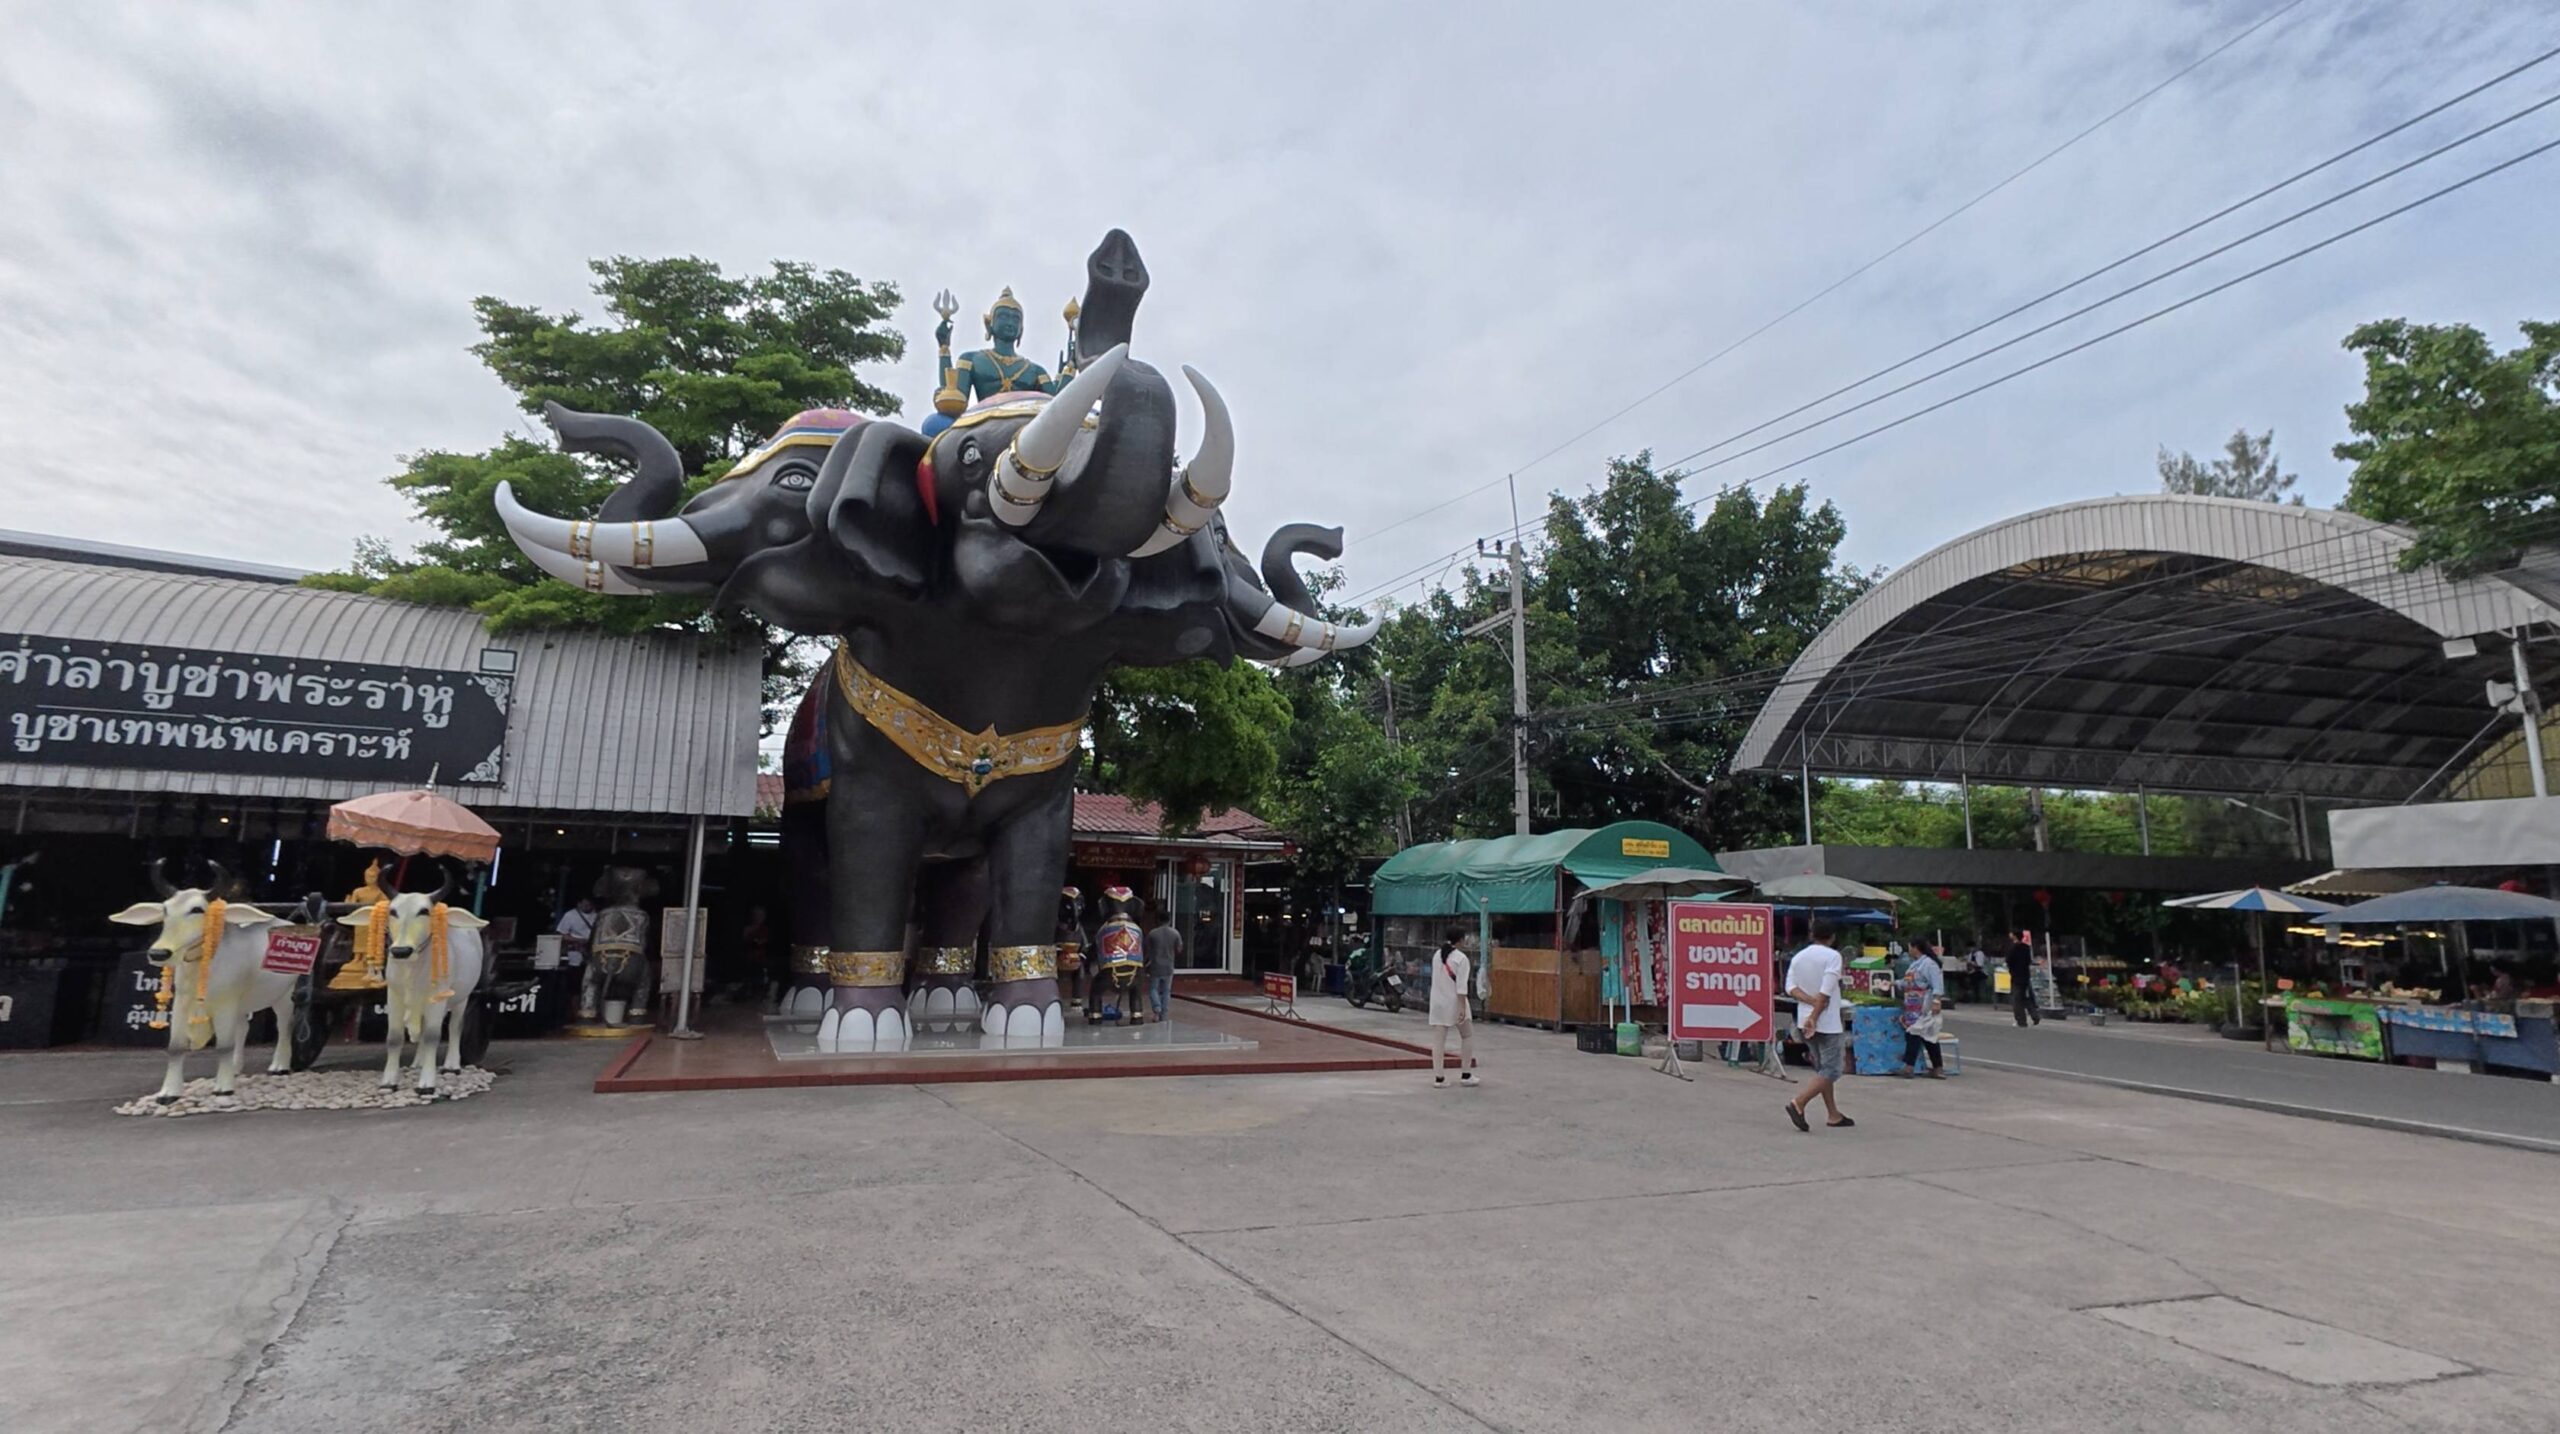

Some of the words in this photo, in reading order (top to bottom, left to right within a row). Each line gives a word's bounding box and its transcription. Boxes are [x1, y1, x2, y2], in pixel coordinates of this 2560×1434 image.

[0, 648, 455, 728] ศาลาบูชาพระราหู
[1679, 914, 1765, 935] ตลาดต้นไม้
[1688, 941, 1758, 965] ของวัด
[1686, 971, 1761, 997] ราคาถูก
